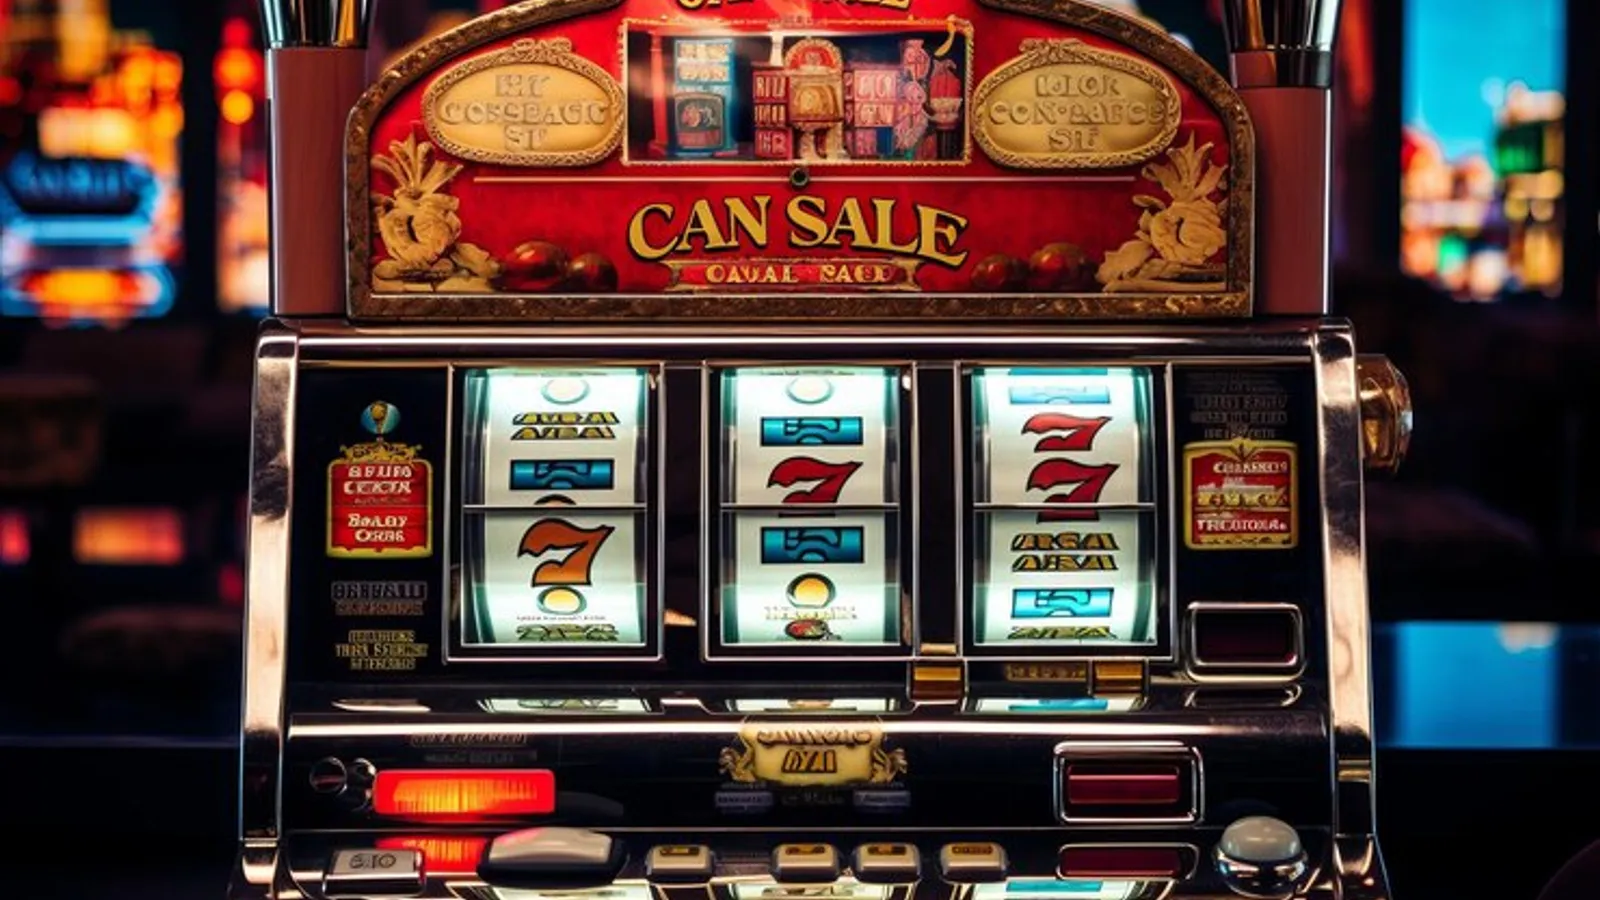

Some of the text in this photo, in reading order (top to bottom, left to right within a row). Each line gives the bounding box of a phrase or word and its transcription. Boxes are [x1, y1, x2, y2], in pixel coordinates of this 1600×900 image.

[627, 194, 968, 267] CAN SALE
[1020, 411, 1113, 454] 7
[766, 455, 864, 518] 7
[1025, 457, 1121, 525] 7
[517, 517, 616, 588] 7
